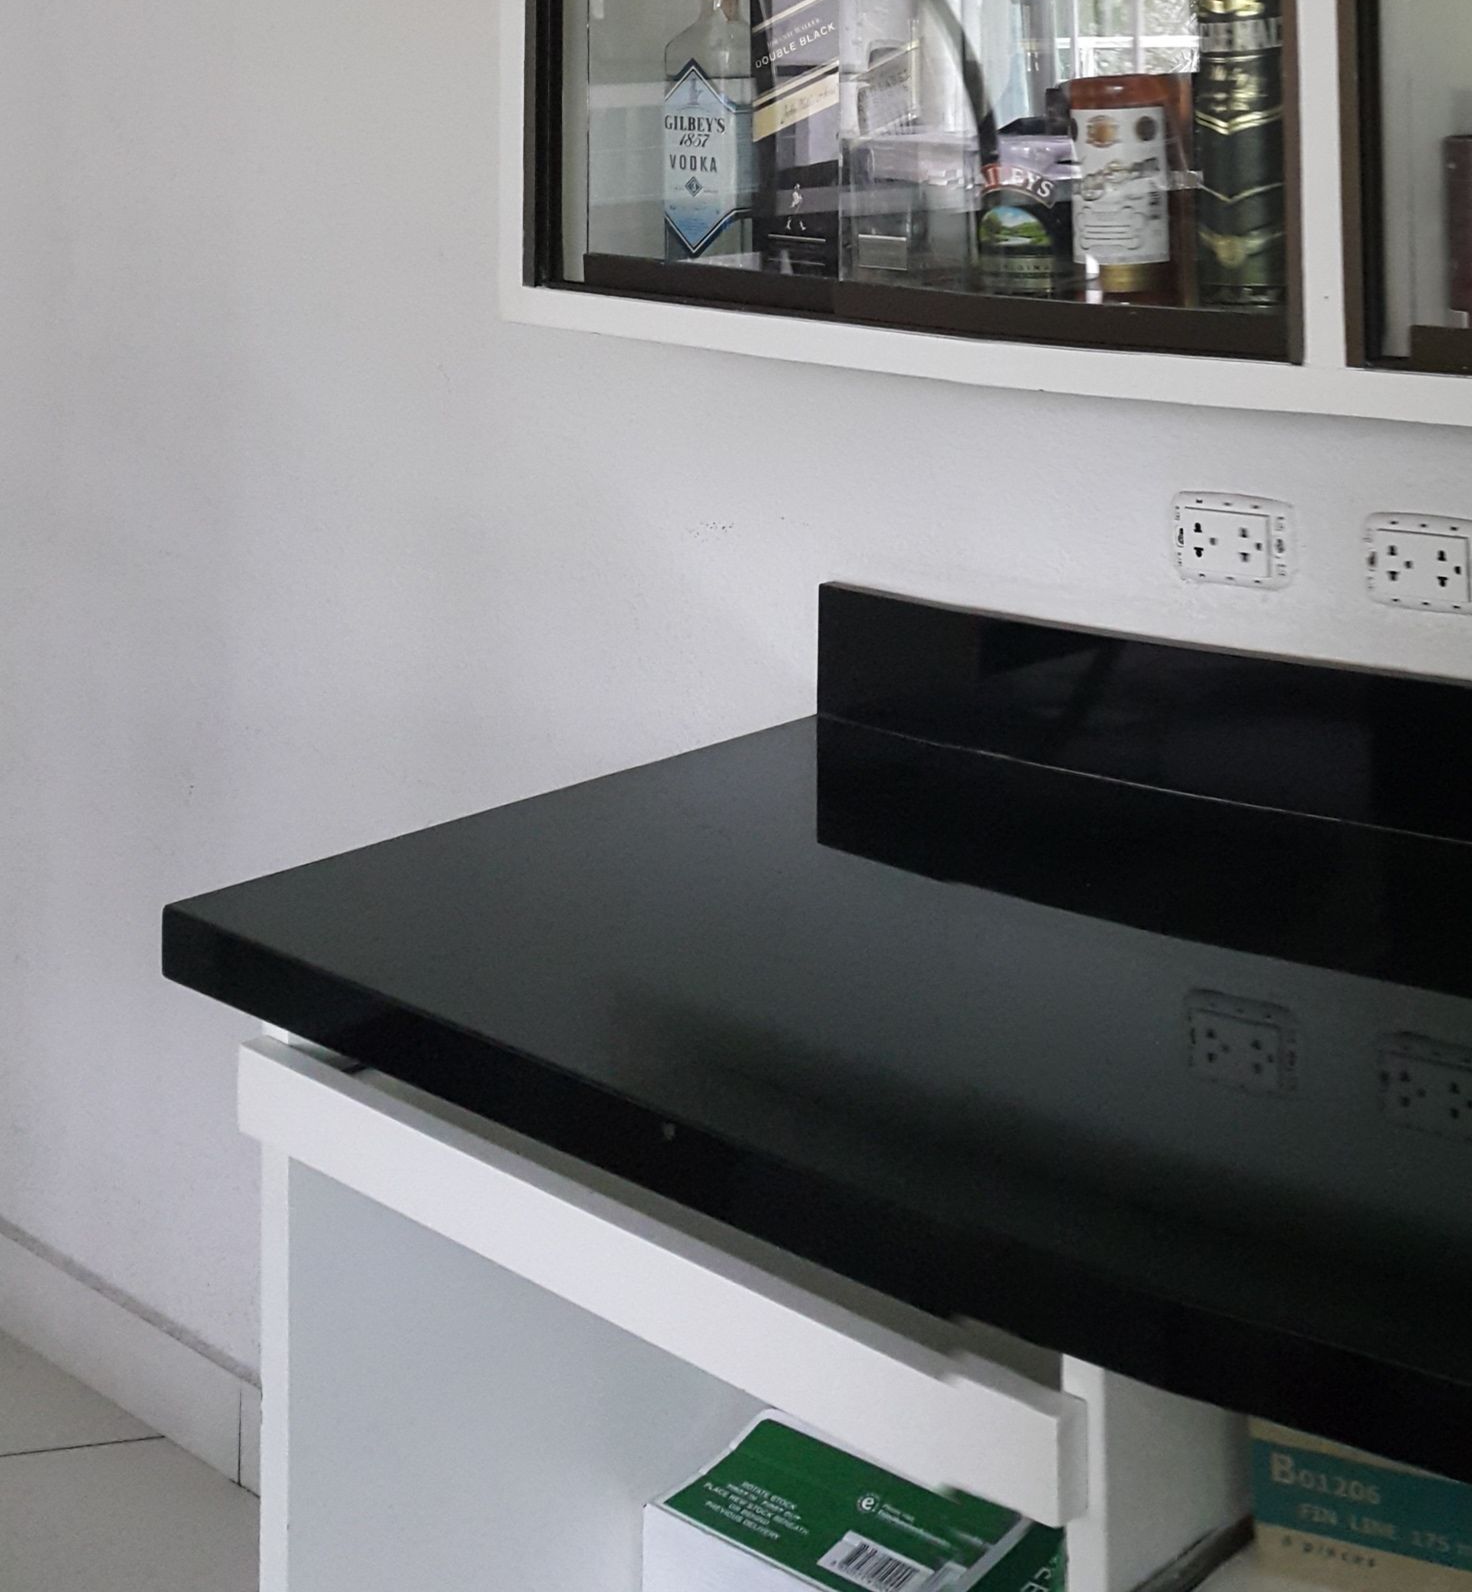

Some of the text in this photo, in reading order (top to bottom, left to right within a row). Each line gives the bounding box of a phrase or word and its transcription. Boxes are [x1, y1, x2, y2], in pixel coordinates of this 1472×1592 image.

[755, 22, 836, 69] DOUBLE BLACK
[664, 114, 726, 134] GILBEY'S
[679, 132, 710, 149] 1857
[669, 153, 718, 173] VODKA
[703, 1481, 730, 1498] PLACE
[746, 1502, 774, 1519] STOCK
